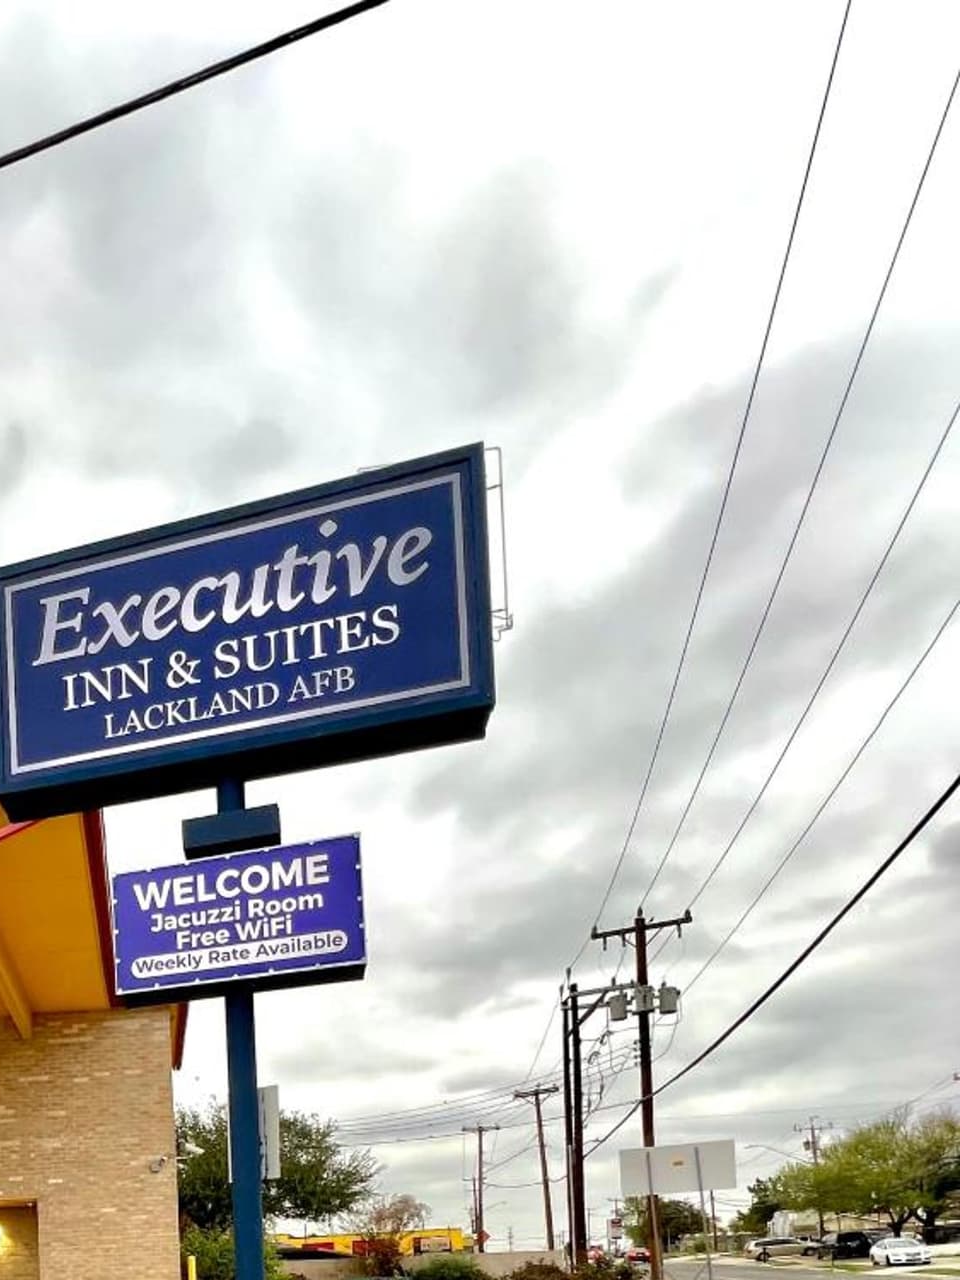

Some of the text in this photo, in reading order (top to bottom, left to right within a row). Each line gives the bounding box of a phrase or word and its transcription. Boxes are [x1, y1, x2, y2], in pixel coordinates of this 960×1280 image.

[32, 519, 433, 666] Executive
[63, 604, 401, 711] INN & SUITES
[104, 666, 356, 738] LACKLAND AFB
[133, 854, 330, 911] WELCOME
[150, 893, 324, 933] Jacuzzi Room
[176, 915, 293, 950] Free WiFi
[136, 933, 344, 974] Weekly Rate Available
